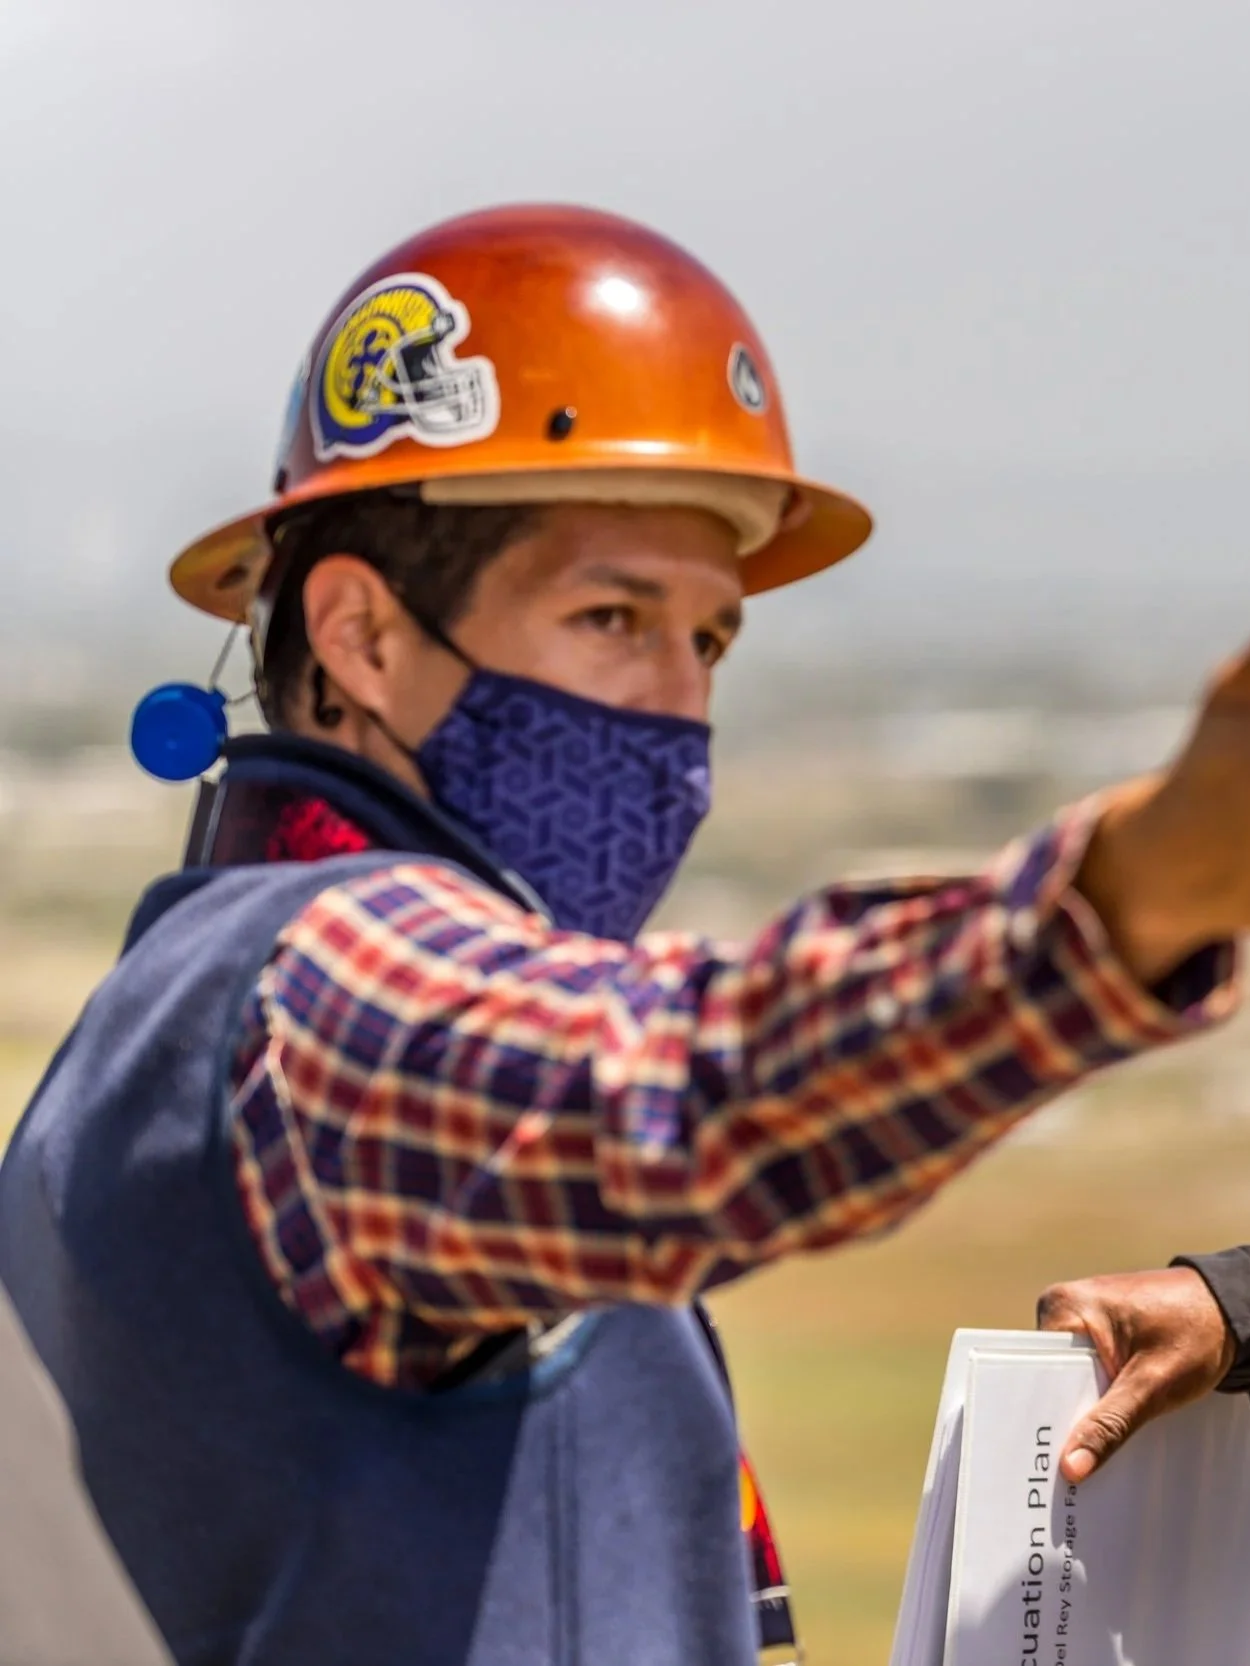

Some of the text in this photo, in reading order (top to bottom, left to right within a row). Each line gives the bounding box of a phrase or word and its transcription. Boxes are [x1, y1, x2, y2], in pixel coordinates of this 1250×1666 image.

[1027, 1426, 1052, 1509] Plan
[1059, 1514, 1077, 1593] Storage
[1056, 1599, 1073, 1636] Rey
